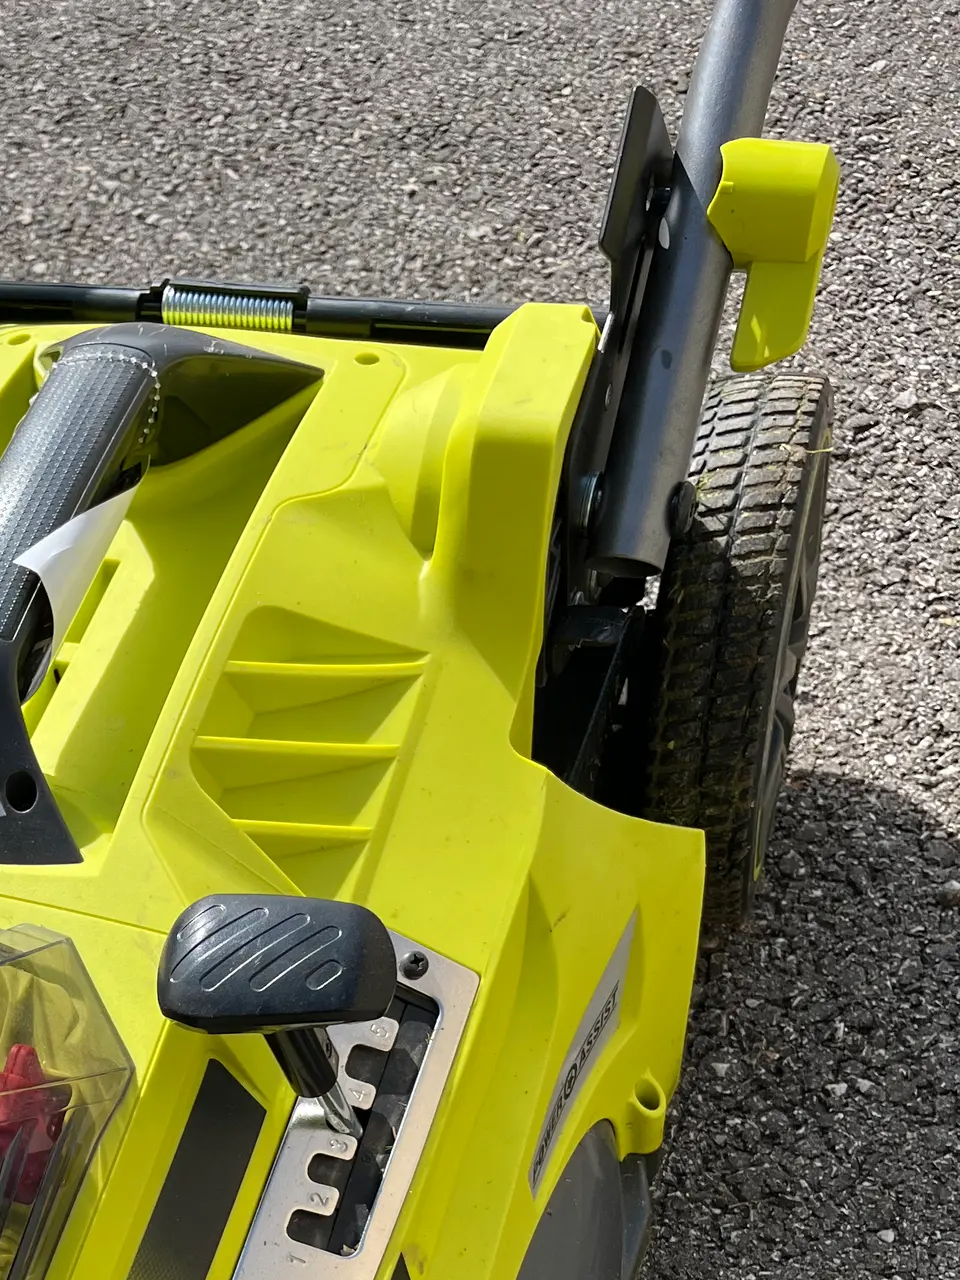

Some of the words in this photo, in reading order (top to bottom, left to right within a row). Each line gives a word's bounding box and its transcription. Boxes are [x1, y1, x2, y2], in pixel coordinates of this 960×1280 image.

[369, 1022, 389, 1040] 5
[578, 991, 618, 1066] ASSIST
[349, 1086, 371, 1102] 4
[329, 1138, 349, 1154] 3
[309, 1191, 330, 1207] 2
